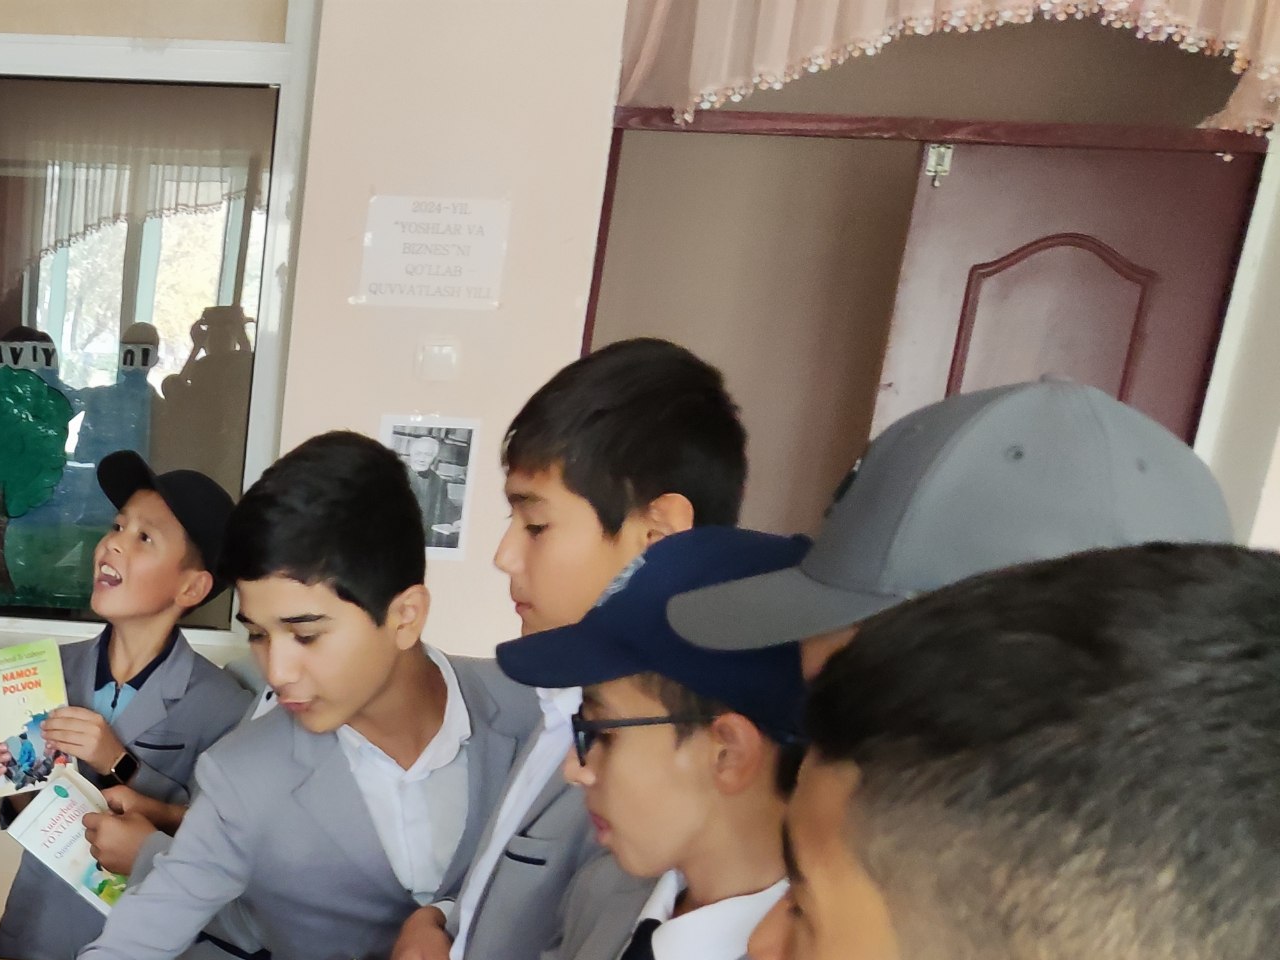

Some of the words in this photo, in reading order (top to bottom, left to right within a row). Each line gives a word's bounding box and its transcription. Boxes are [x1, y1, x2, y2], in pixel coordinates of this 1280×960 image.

[467, 224, 485, 236] VA
[368, 282, 461, 298] QUVVATLASH
[2, 666, 38, 682] NAMOZ
[2, 679, 41, 696] POLVON
